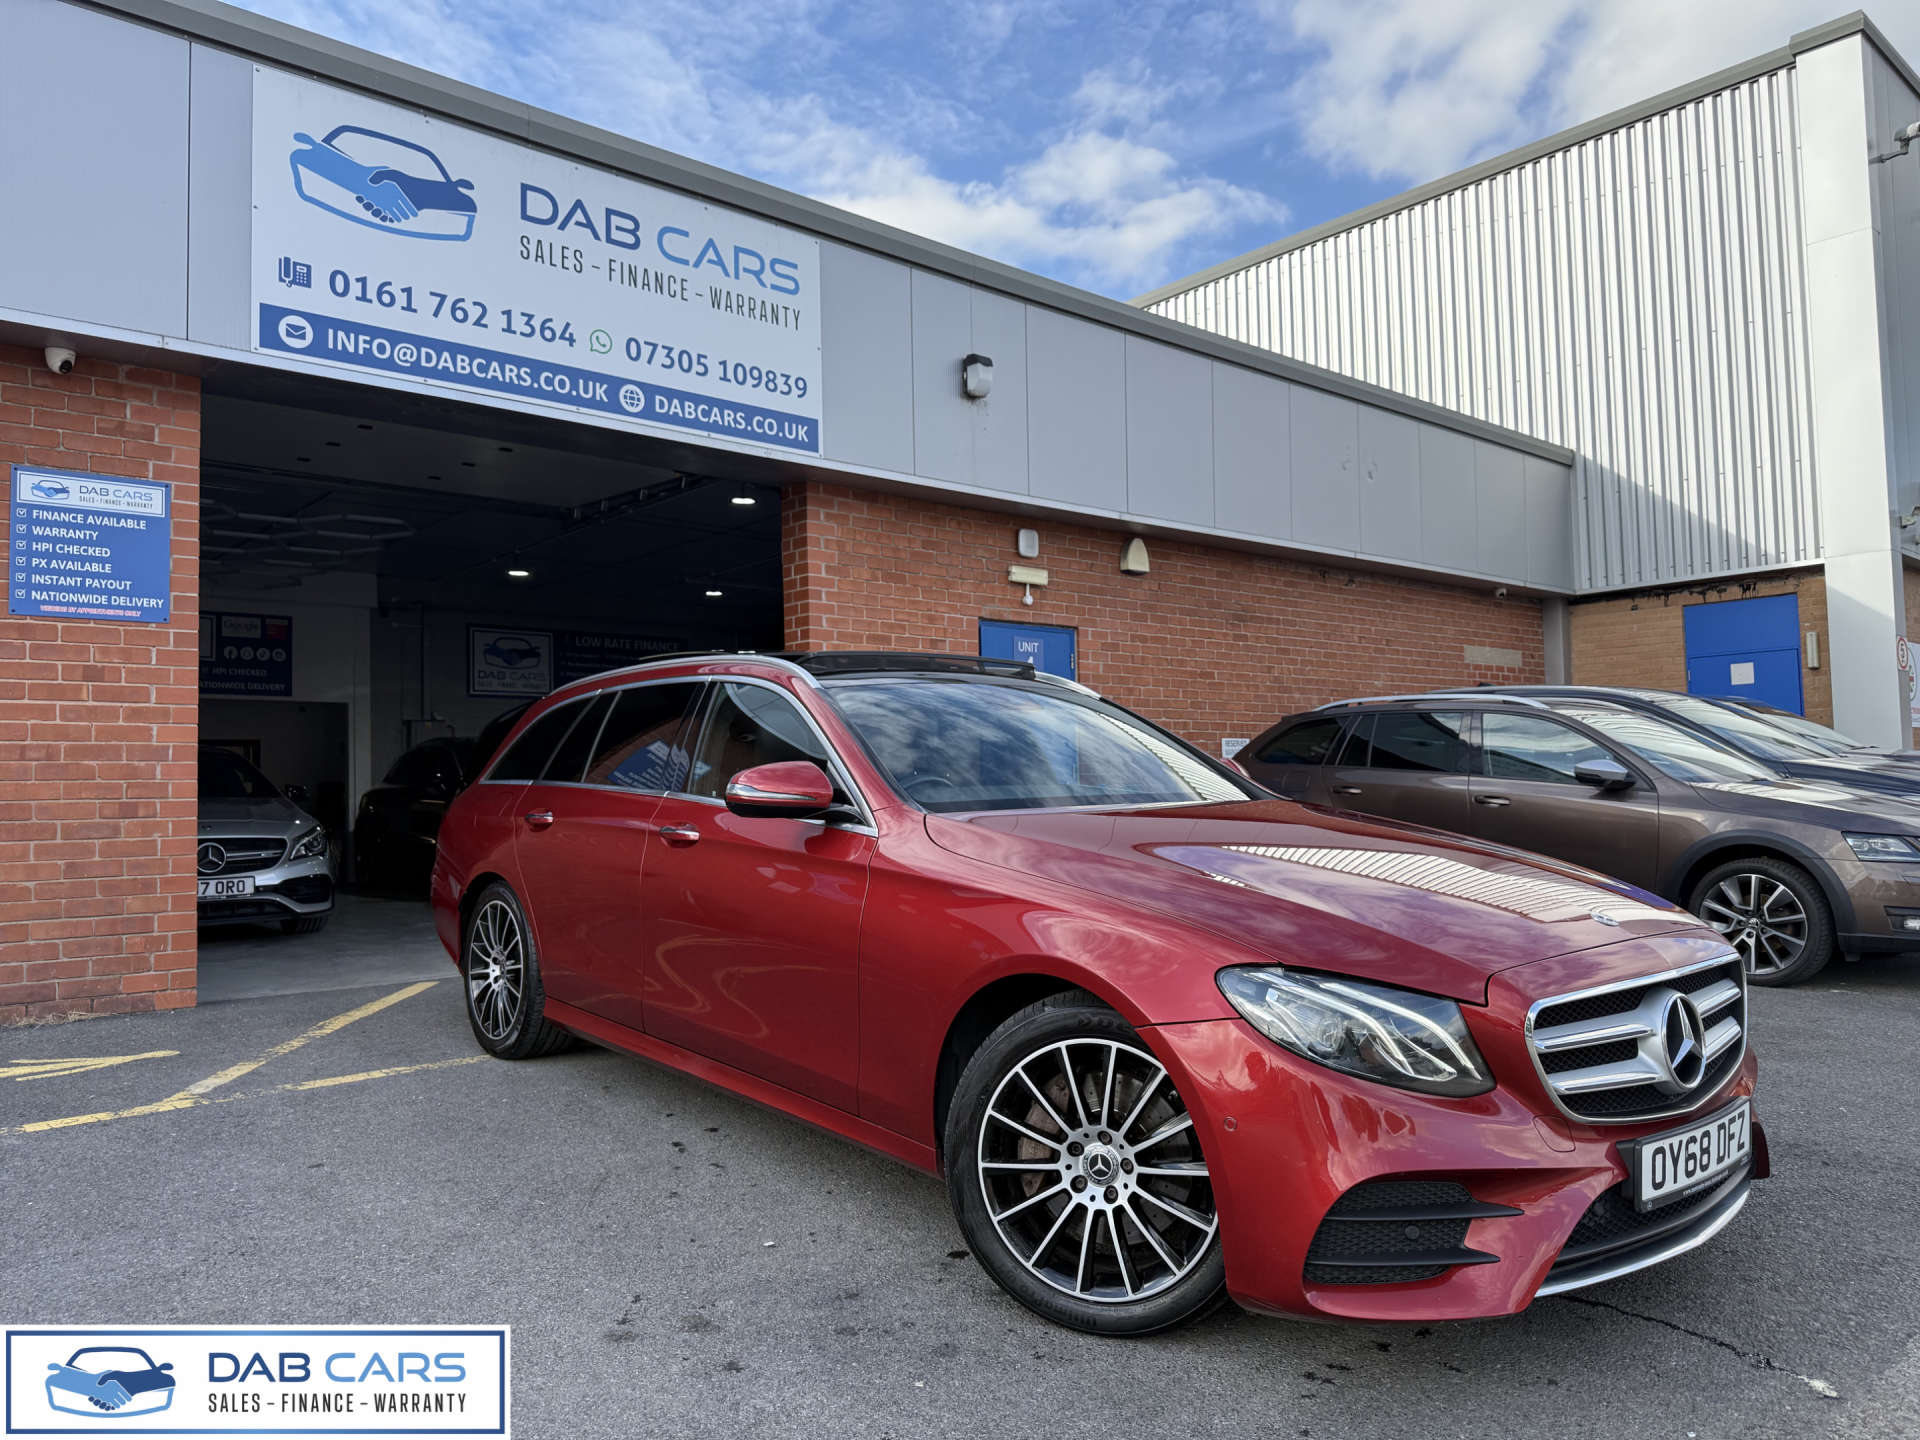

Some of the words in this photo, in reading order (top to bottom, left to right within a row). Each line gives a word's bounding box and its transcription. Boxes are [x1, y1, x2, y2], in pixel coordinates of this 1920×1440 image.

[520, 182, 641, 250] DAB
[657, 226, 800, 296] CARS
[520, 235, 584, 274] SALES
[608, 259, 689, 302] FINANCE
[710, 286, 801, 331] WARRANTY
[329, 269, 417, 314] 0161
[429, 292, 489, 329] 762
[500, 308, 577, 348] 1364
[327, 327, 609, 403] INFO@DABCARS.CO.UK
[624, 337, 709, 378] 07305
[718, 360, 808, 399] 109839
[654, 394, 809, 444] DABCARS.CO.UK
[79, 485, 109, 497] DAB
[113, 489, 153, 501] CARS
[32, 509, 84, 524] FINANCE
[86, 515, 147, 530] AVAILABLE
[32, 525, 98, 540] WARRANTY
[32, 542, 52, 553] HPI
[56, 543, 110, 557] CHECKED
[32, 558, 47, 568] PX
[50, 560, 112, 573] AVAILABLE
[32, 574, 82, 587] INSTANT
[85, 578, 132, 591] PAYOUT
[31, 590, 108, 605] NATIONWIDE
[111, 595, 164, 608] DELIVERY
[575, 635, 601, 648] LOW
[603, 638, 632, 650] RATE
[633, 639, 680, 651] FINANCE
[1018, 641, 1039, 653] UNIT
[215, 880, 245, 895] ORO
[1651, 1129, 1711, 1191] OY68
[1716, 1109, 1745, 1165] DFZ
